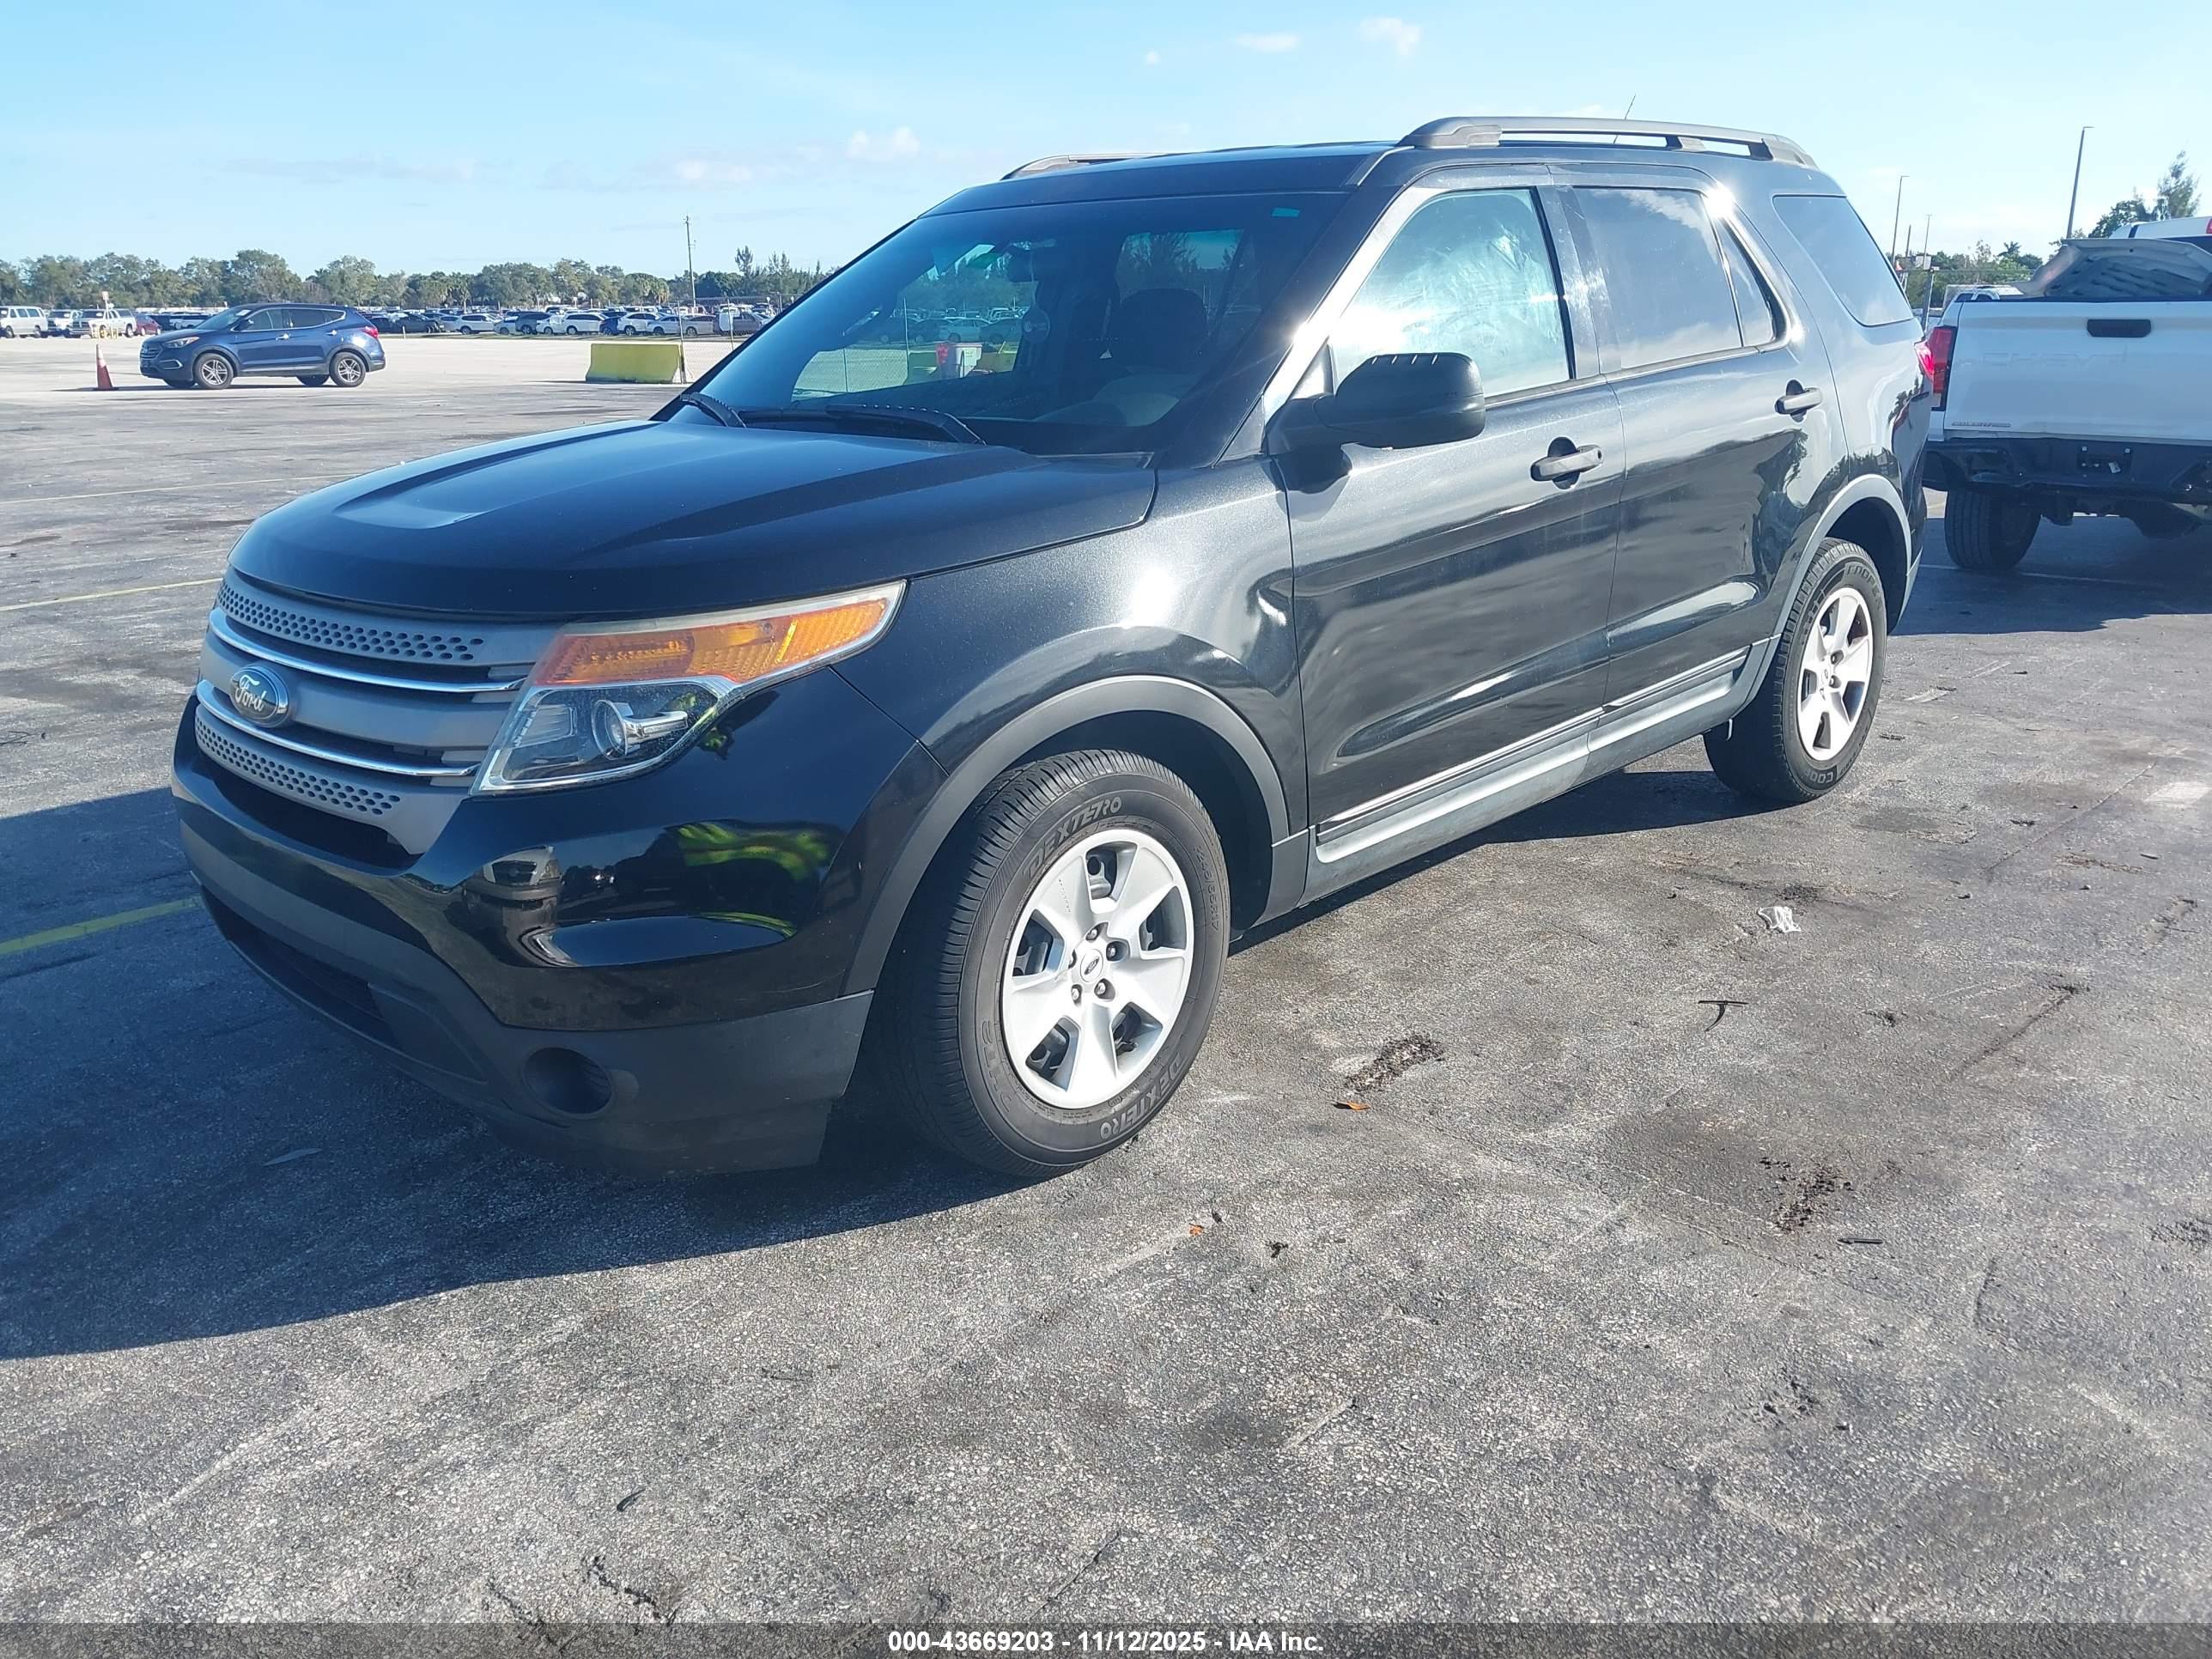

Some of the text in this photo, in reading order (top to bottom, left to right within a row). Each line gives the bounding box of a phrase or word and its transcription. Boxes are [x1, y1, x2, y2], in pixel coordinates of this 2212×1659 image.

[234, 674, 267, 712] Ford
[1023, 796, 1122, 878] DEXTERO
[1100, 1051, 1184, 1140] DEXTERO
